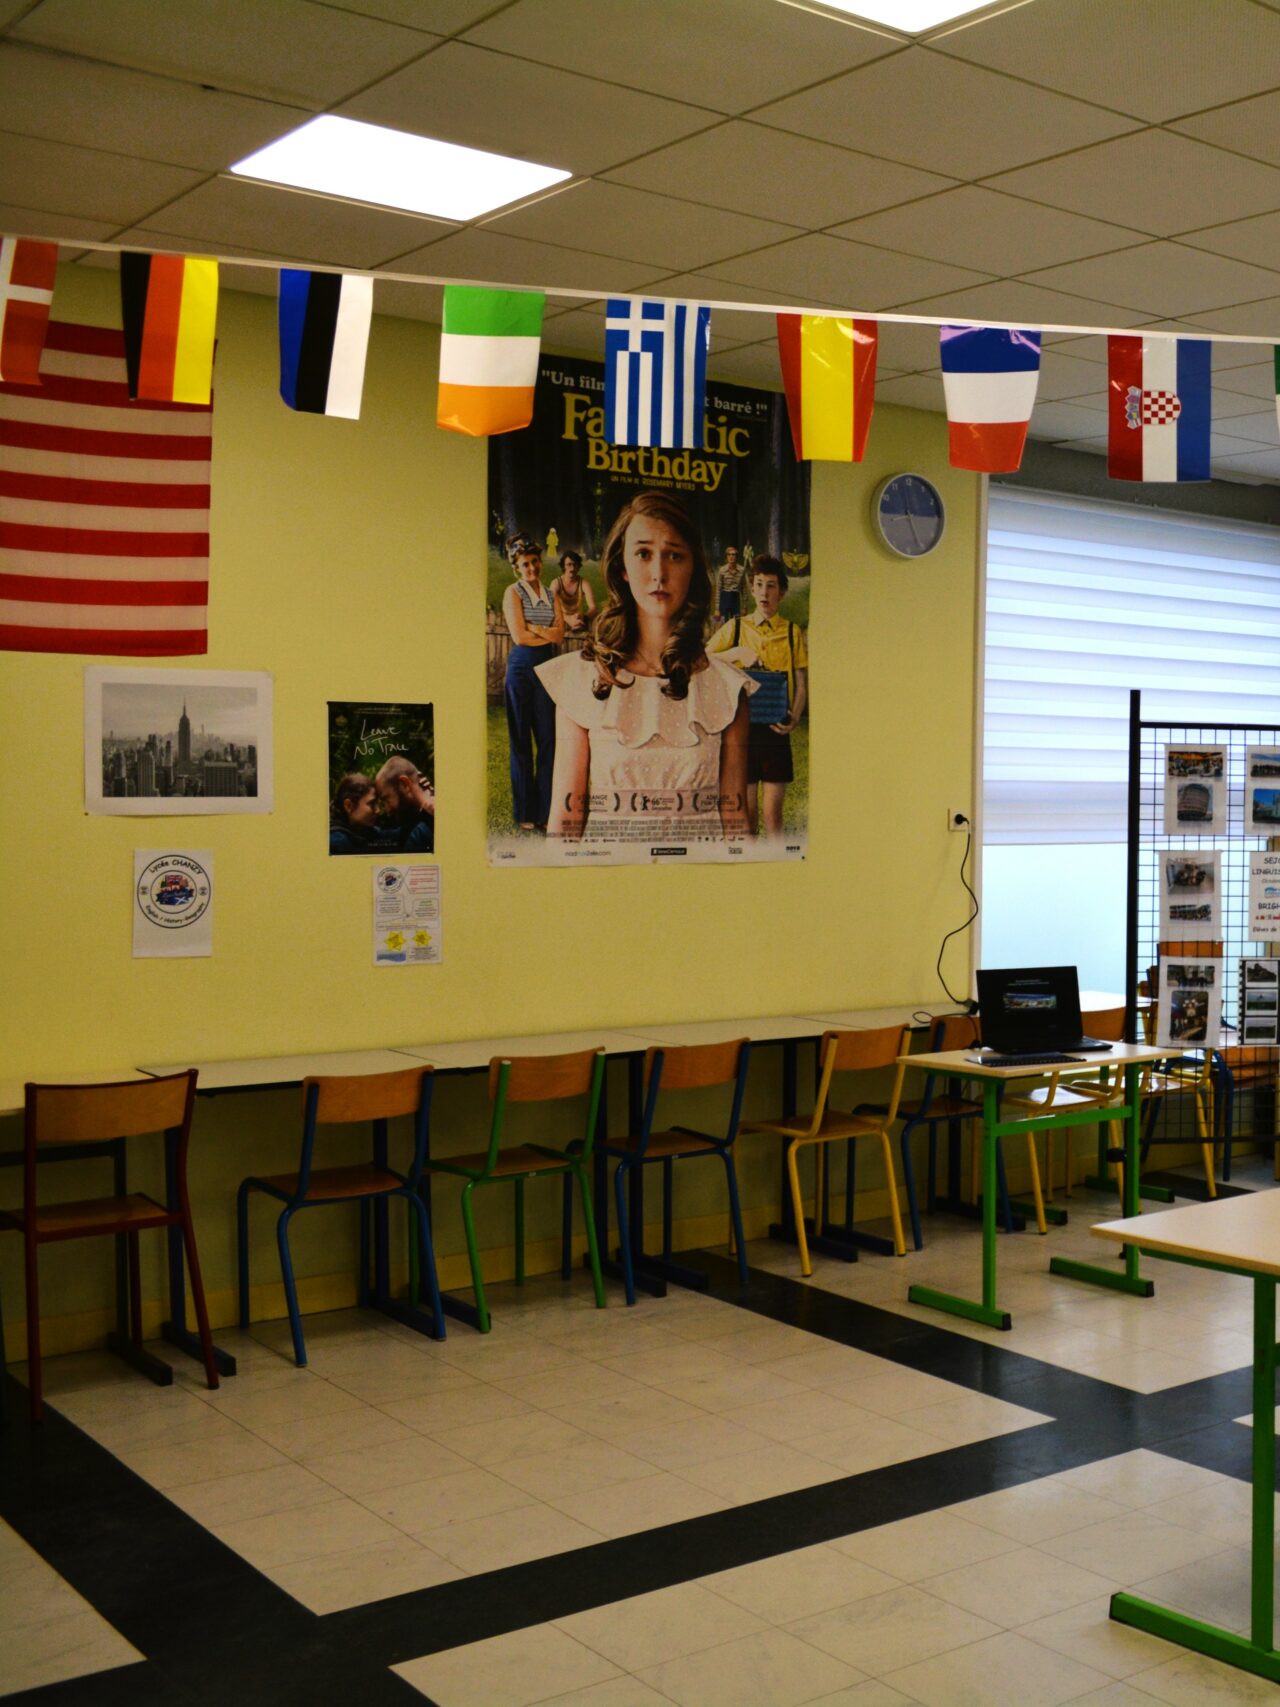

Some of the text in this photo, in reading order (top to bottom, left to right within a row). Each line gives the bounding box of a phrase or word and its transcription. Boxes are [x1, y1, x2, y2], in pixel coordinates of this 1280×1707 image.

[714, 396, 752, 414] barré
[562, 392, 751, 457] Fatic
[586, 437, 728, 491] Birthday
[172, 859, 203, 875] CHANZY
